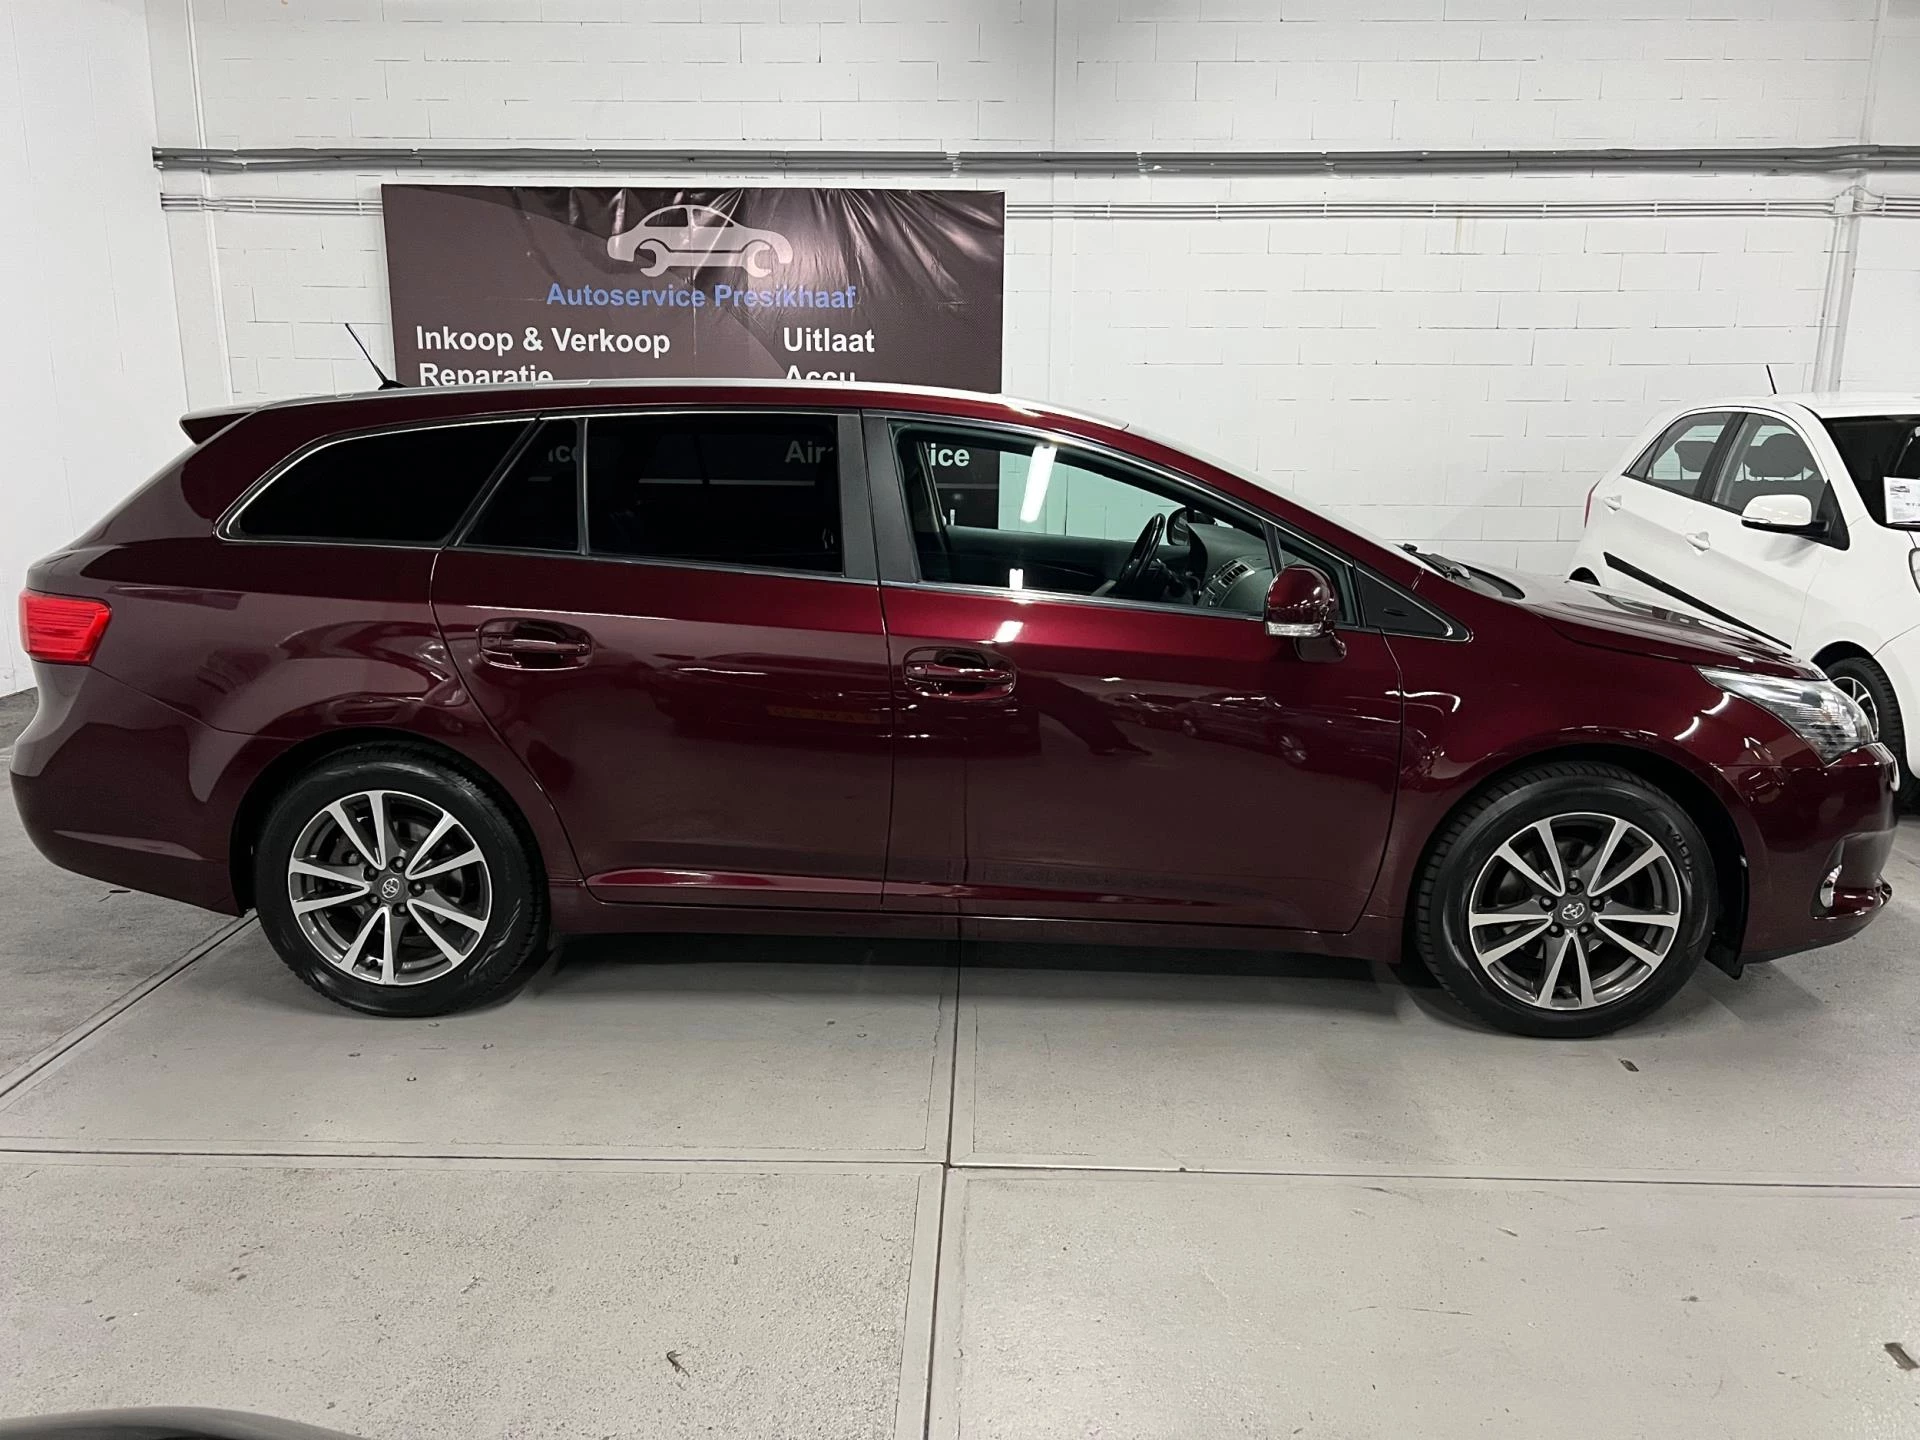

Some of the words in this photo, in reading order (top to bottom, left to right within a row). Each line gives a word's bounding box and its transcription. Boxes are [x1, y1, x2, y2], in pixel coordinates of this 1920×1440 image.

[546, 283, 705, 307] Autoservice
[714, 284, 856, 309] Presikhaaf
[416, 326, 514, 356] Inkoop
[522, 326, 544, 351] &
[551, 328, 671, 359] Verkoop
[783, 327, 875, 353] Uitlaat
[419, 363, 554, 387] Reparatie
[784, 440, 834, 464] Air
[927, 442, 970, 467] ice
